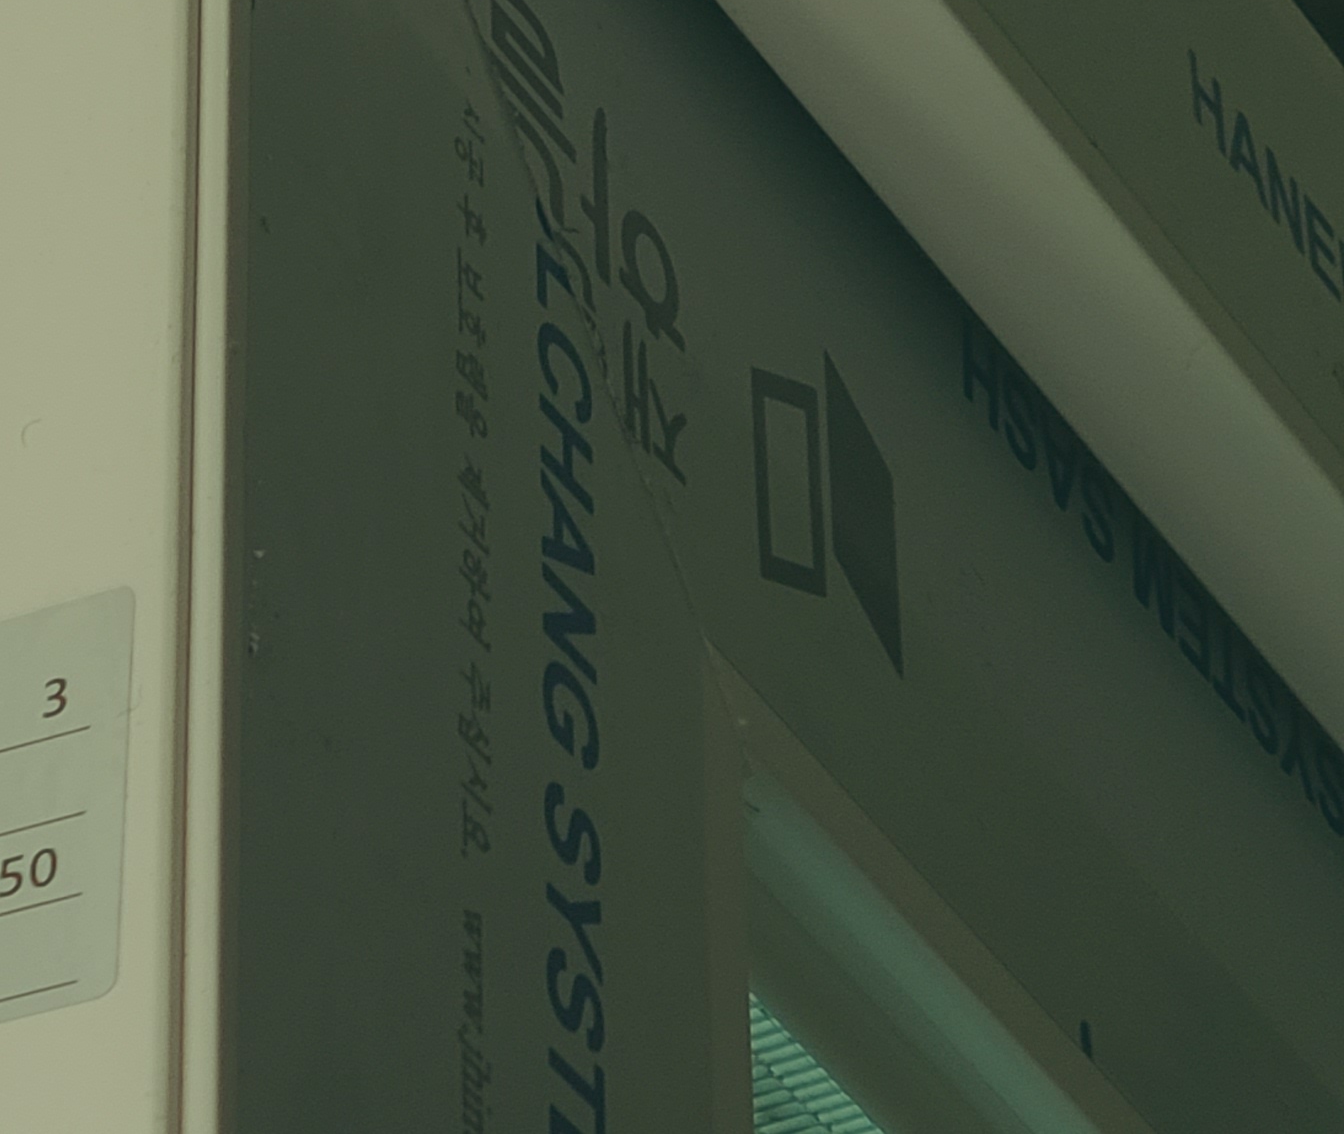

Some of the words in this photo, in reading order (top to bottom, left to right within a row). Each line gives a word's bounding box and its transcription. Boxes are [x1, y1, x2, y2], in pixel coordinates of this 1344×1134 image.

[1187, 48, 1344, 303] HANE
[536, 197, 601, 770] LCHANG
[42, 678, 69, 719] 3
